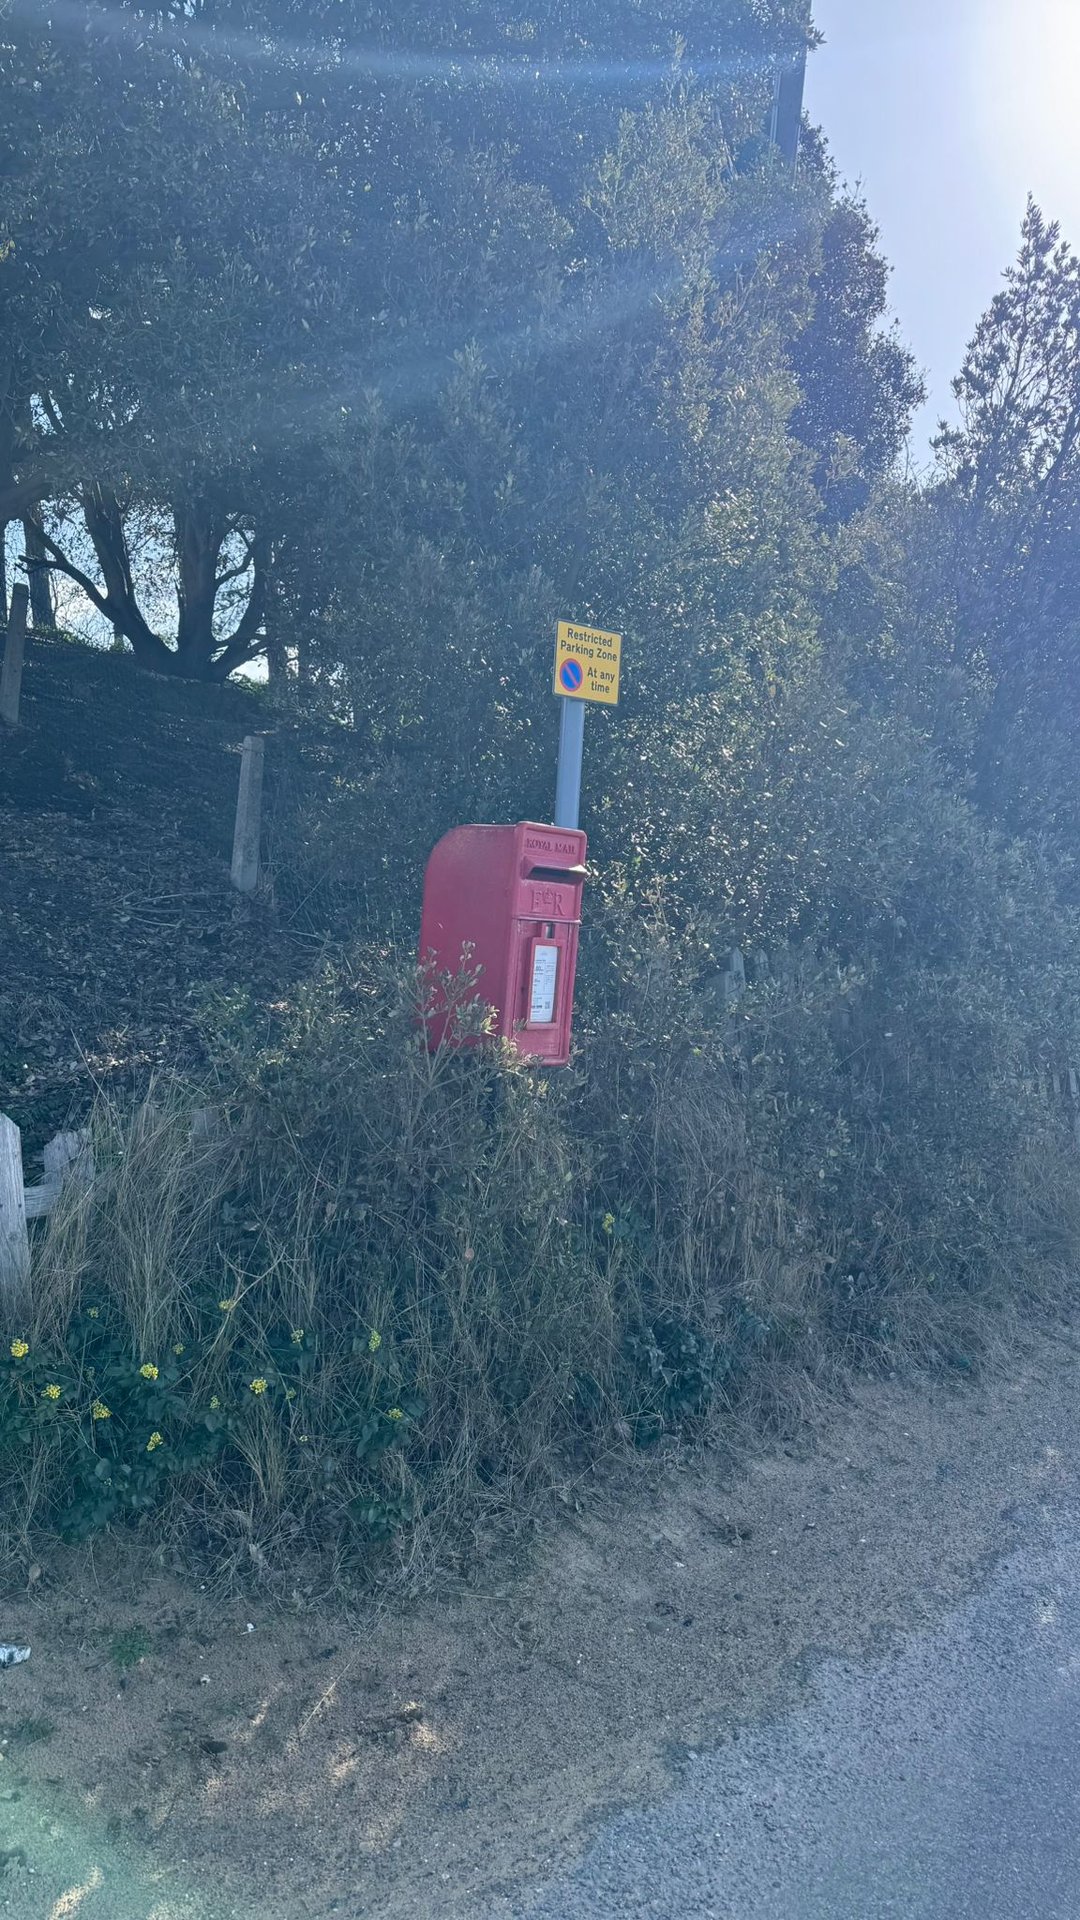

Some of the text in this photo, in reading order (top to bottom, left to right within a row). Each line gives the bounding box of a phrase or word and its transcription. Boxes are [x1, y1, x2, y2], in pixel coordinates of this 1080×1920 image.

[567, 628, 613, 647] Restricted
[560, 640, 617, 661] Parking Zone
[587, 667, 615, 683] At any
[591, 681, 610, 693] time
[526, 838, 576, 855] ROYAL MAIL
